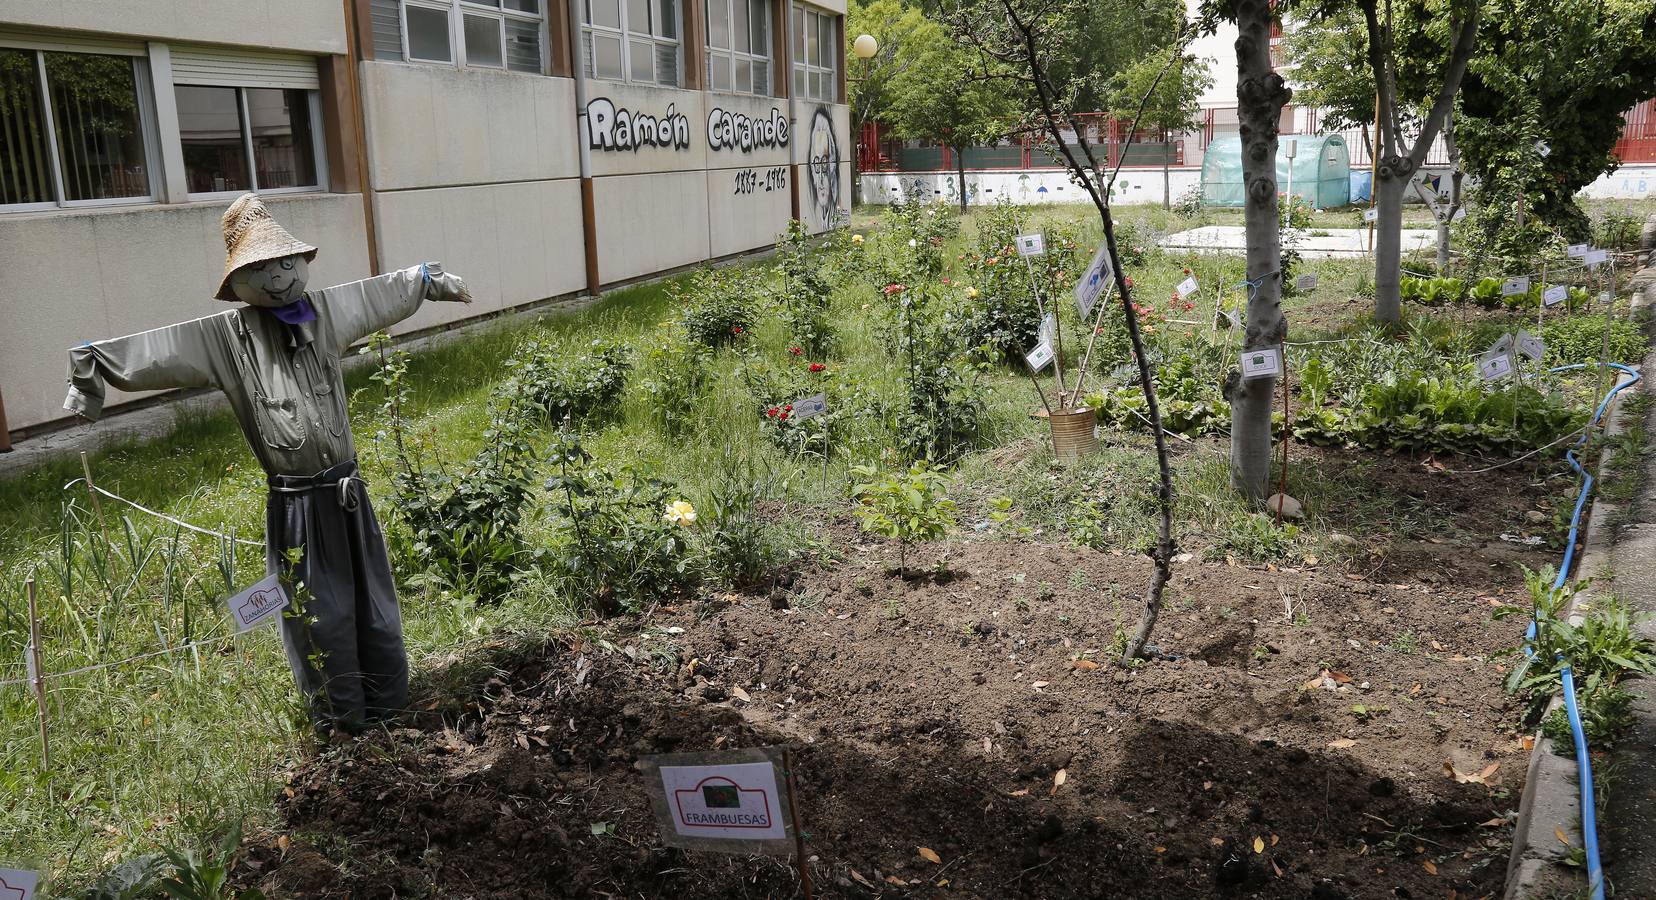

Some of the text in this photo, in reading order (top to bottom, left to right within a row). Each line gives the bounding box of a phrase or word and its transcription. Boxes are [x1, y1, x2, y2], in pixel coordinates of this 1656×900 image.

[587, 97, 690, 154] Ramón
[244, 596, 281, 621] ZANAHORIAS
[686, 812, 768, 825] FRAMBUESAS
